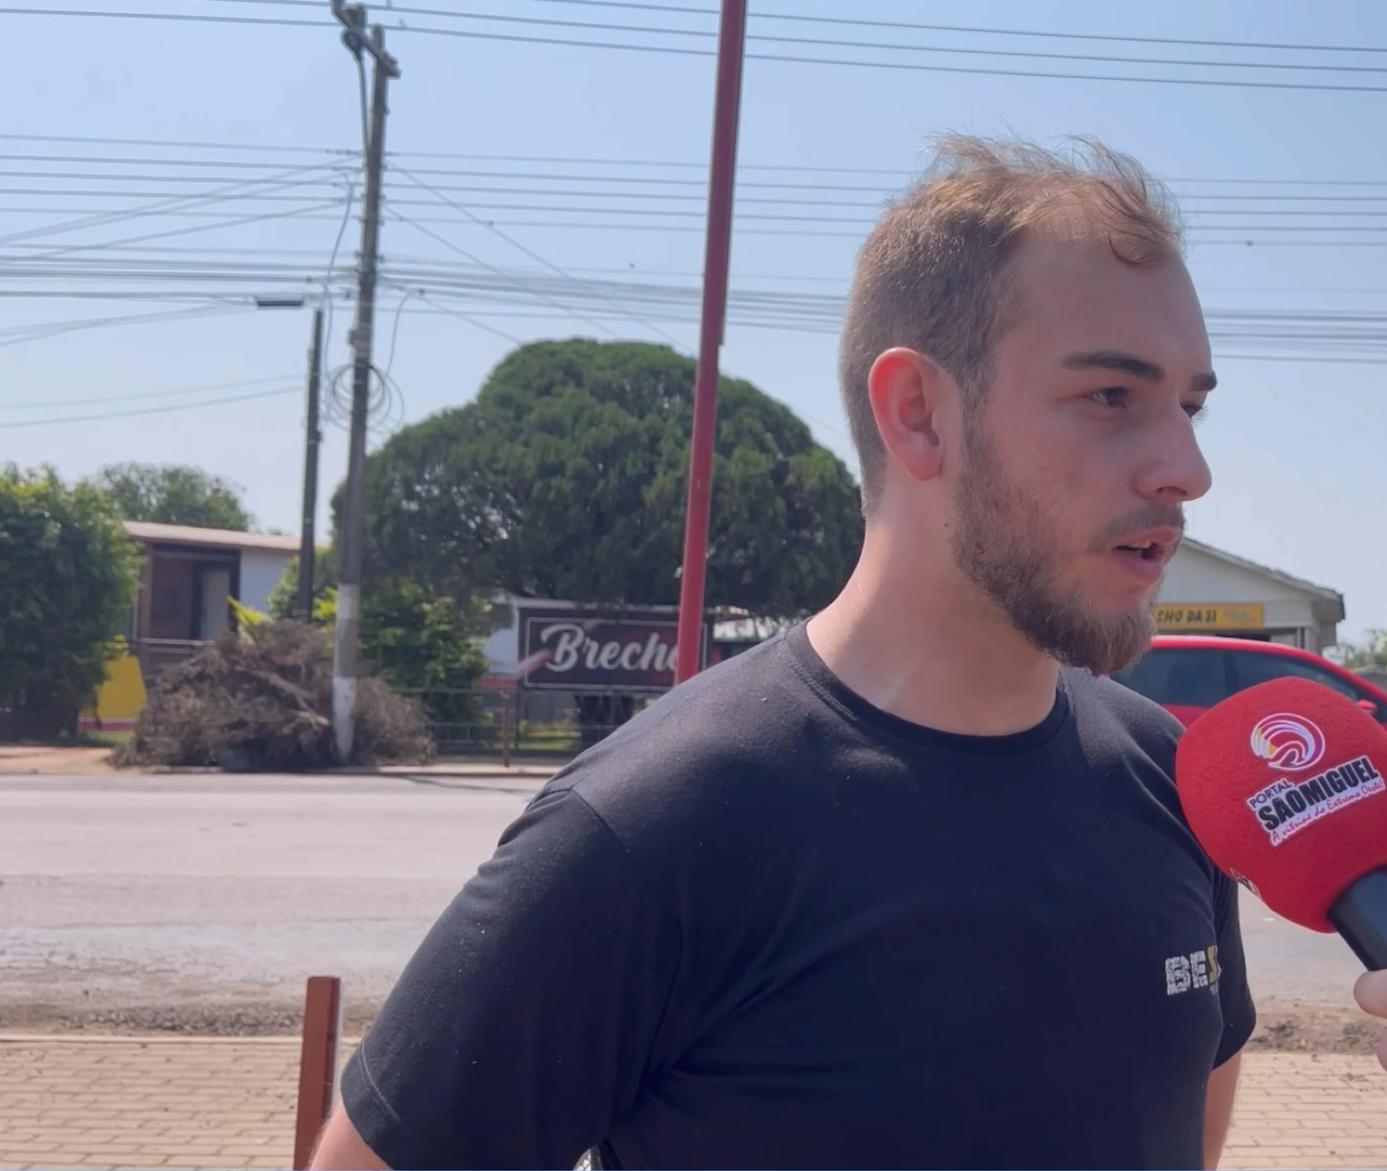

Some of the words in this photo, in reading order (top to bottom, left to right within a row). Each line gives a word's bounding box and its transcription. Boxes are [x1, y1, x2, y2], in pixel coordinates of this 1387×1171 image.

[1156, 609, 1183, 623] CHO
[541, 624, 680, 671] Brech
[1250, 780, 1292, 808] PORTAL
